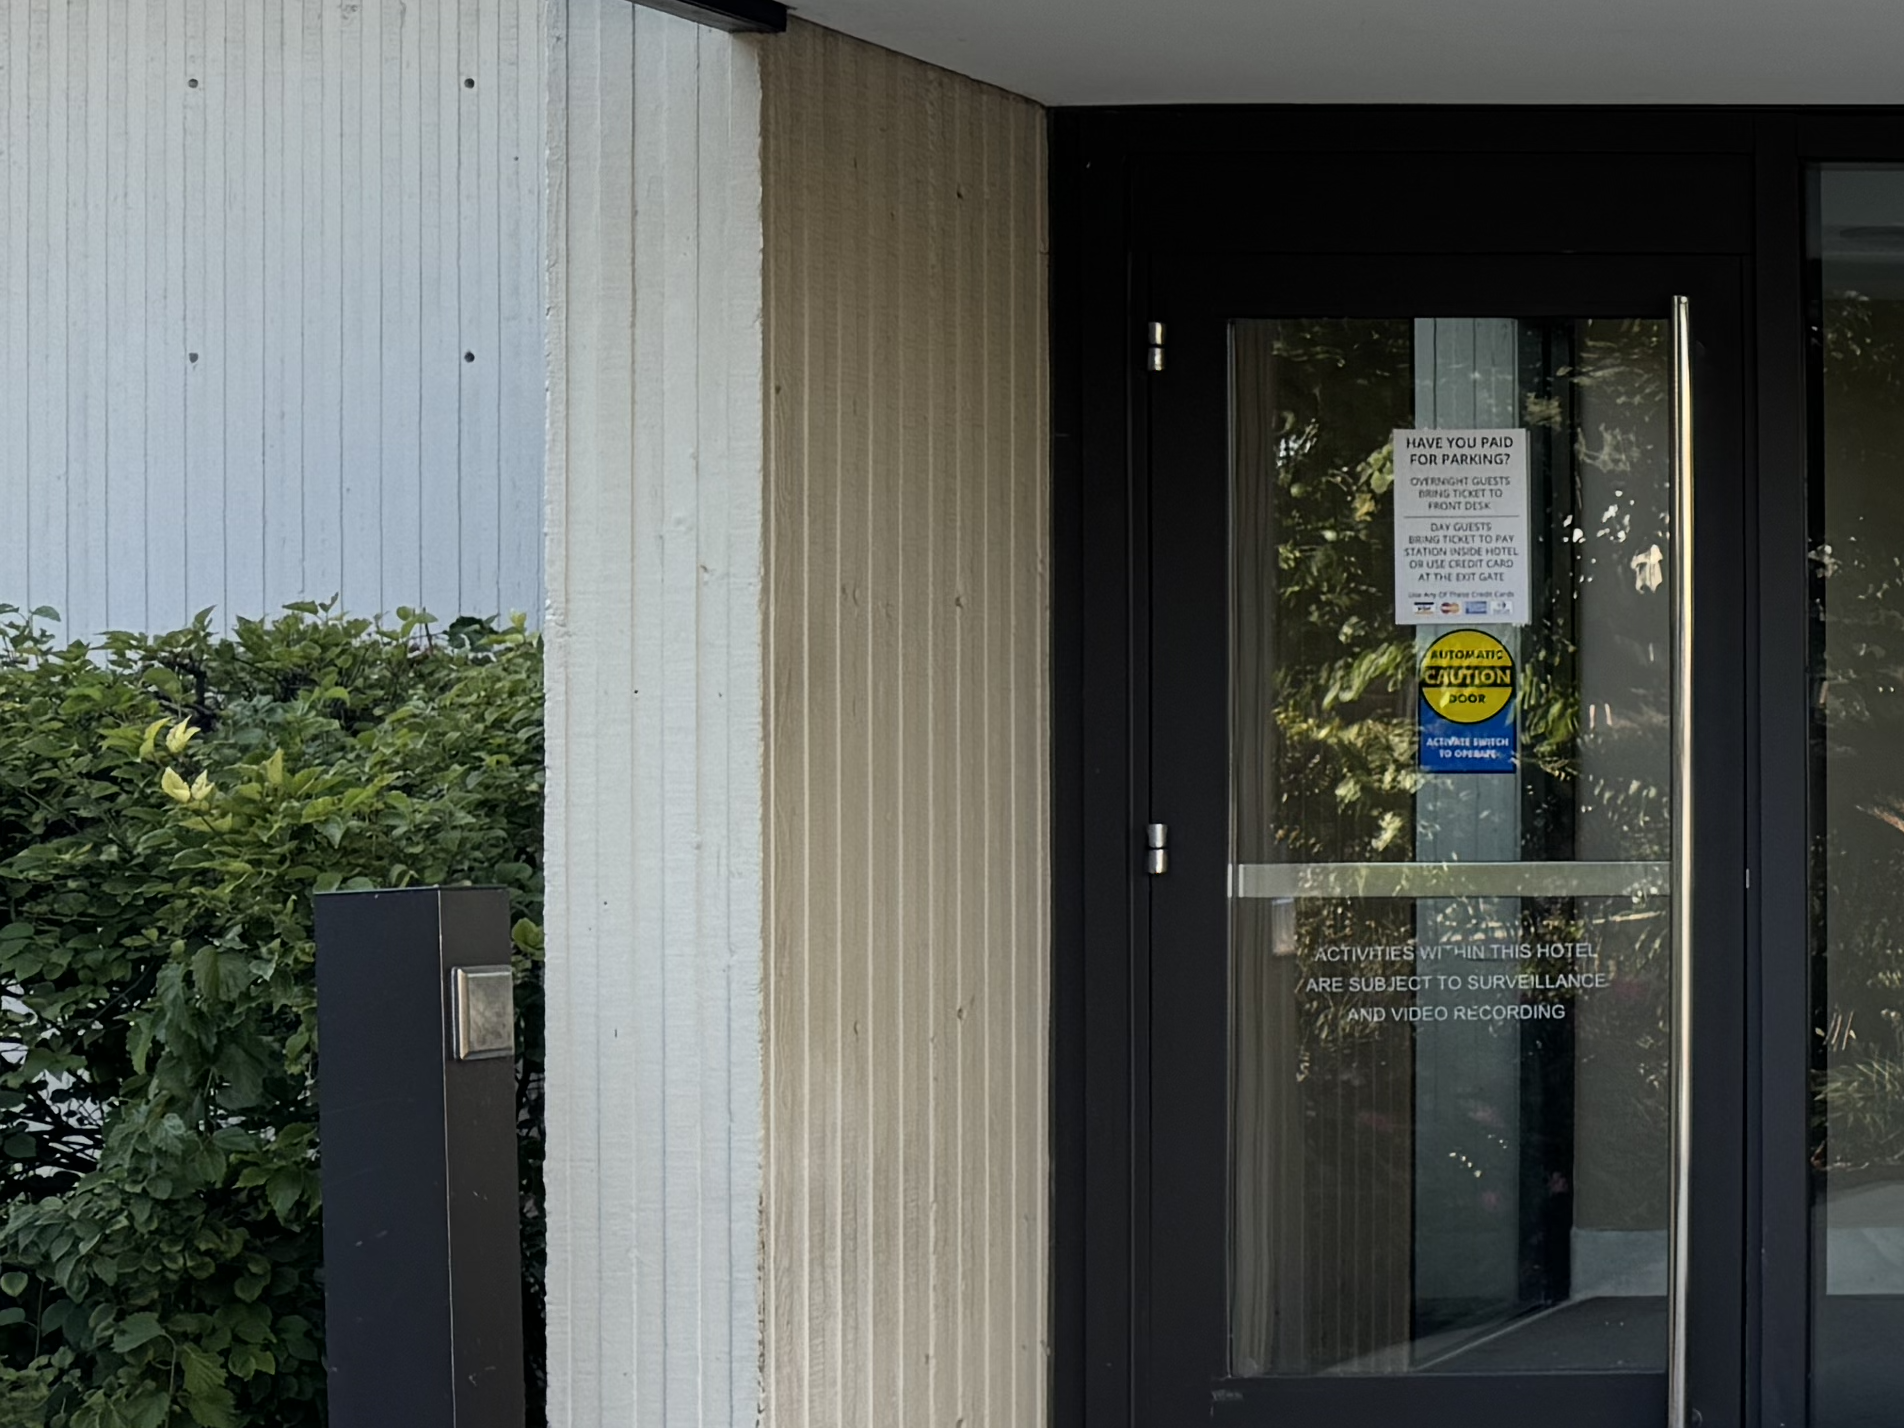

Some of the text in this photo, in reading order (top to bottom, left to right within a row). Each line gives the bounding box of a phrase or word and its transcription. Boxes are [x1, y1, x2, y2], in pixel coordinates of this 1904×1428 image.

[1406, 436, 1514, 448] HAVE YOU PAID
[1410, 453, 1510, 465] FOR PARKING?
[1410, 476, 1510, 486] OVERNIGHT GUESTS
[1418, 488, 1502, 498] BRING TICKET TO
[1428, 501, 1492, 510] FRONT DESK
[1430, 522, 1492, 532] DAY GUESTS
[1408, 535, 1514, 544] BRING TICKET TO PAY
[1404, 547, 1518, 556] STATION INSIDE HOTEL
[1410, 559, 1514, 569] OR USE CREDIT CARD
[1418, 572, 1504, 582] AT THE EXIT GATE
[1430, 649, 1504, 660] AUTOMATIC
[1424, 668, 1512, 685] CAUTION
[1448, 693, 1486, 703] DOOR
[1426, 737, 1510, 747] ACTIVATE SWITCH
[1438, 749, 1452, 759] TO
[1315, 946, 1415, 962] ACTIVITIES
[1490, 943, 1531, 959] THIS
[1537, 942, 1598, 958] HOTEL
[1306, 973, 1607, 993] ARE SUBJECT TO SURVEILLANCE
[1347, 1004, 1565, 1022] AND VIDEO RECORDING
